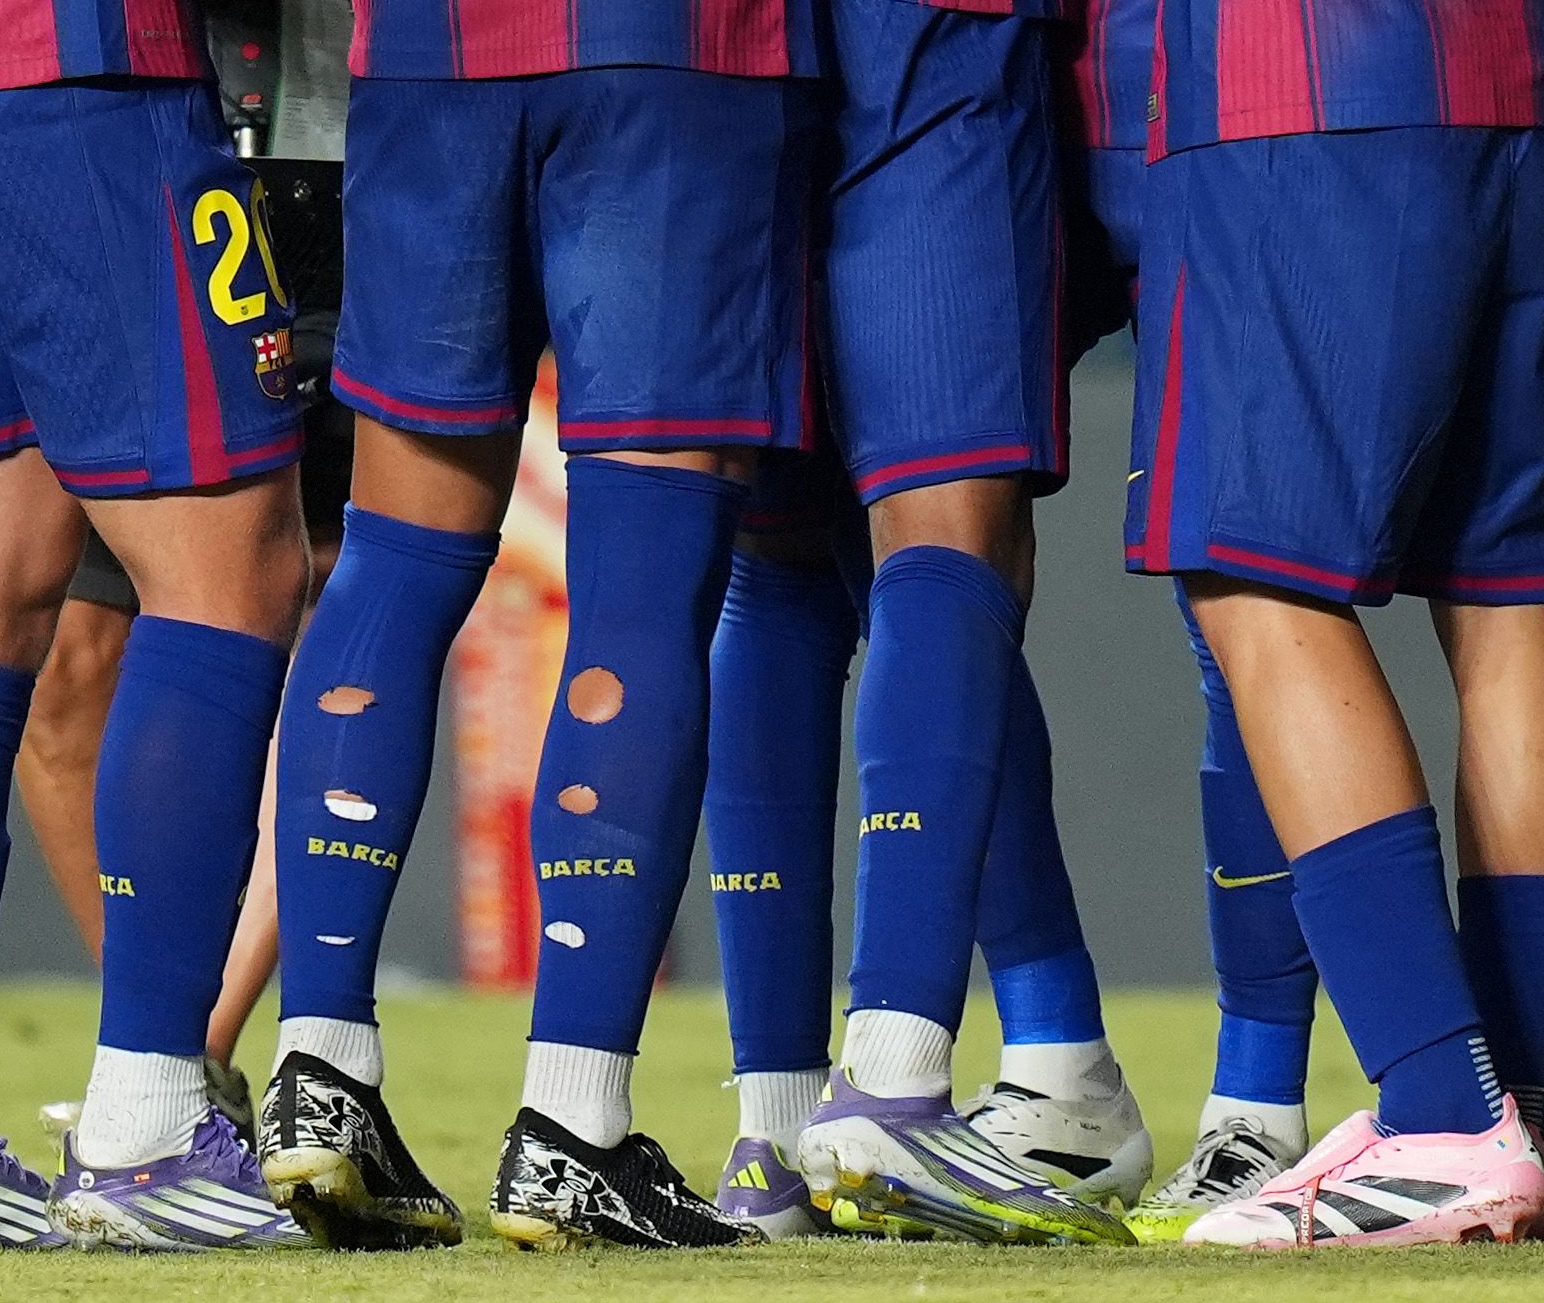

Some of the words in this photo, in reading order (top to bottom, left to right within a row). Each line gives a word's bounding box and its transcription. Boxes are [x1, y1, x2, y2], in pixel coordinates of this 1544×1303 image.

[858, 812, 922, 841] ARÇA
[307, 837, 397, 871] BARÇA
[540, 857, 636, 880] BARÇA
